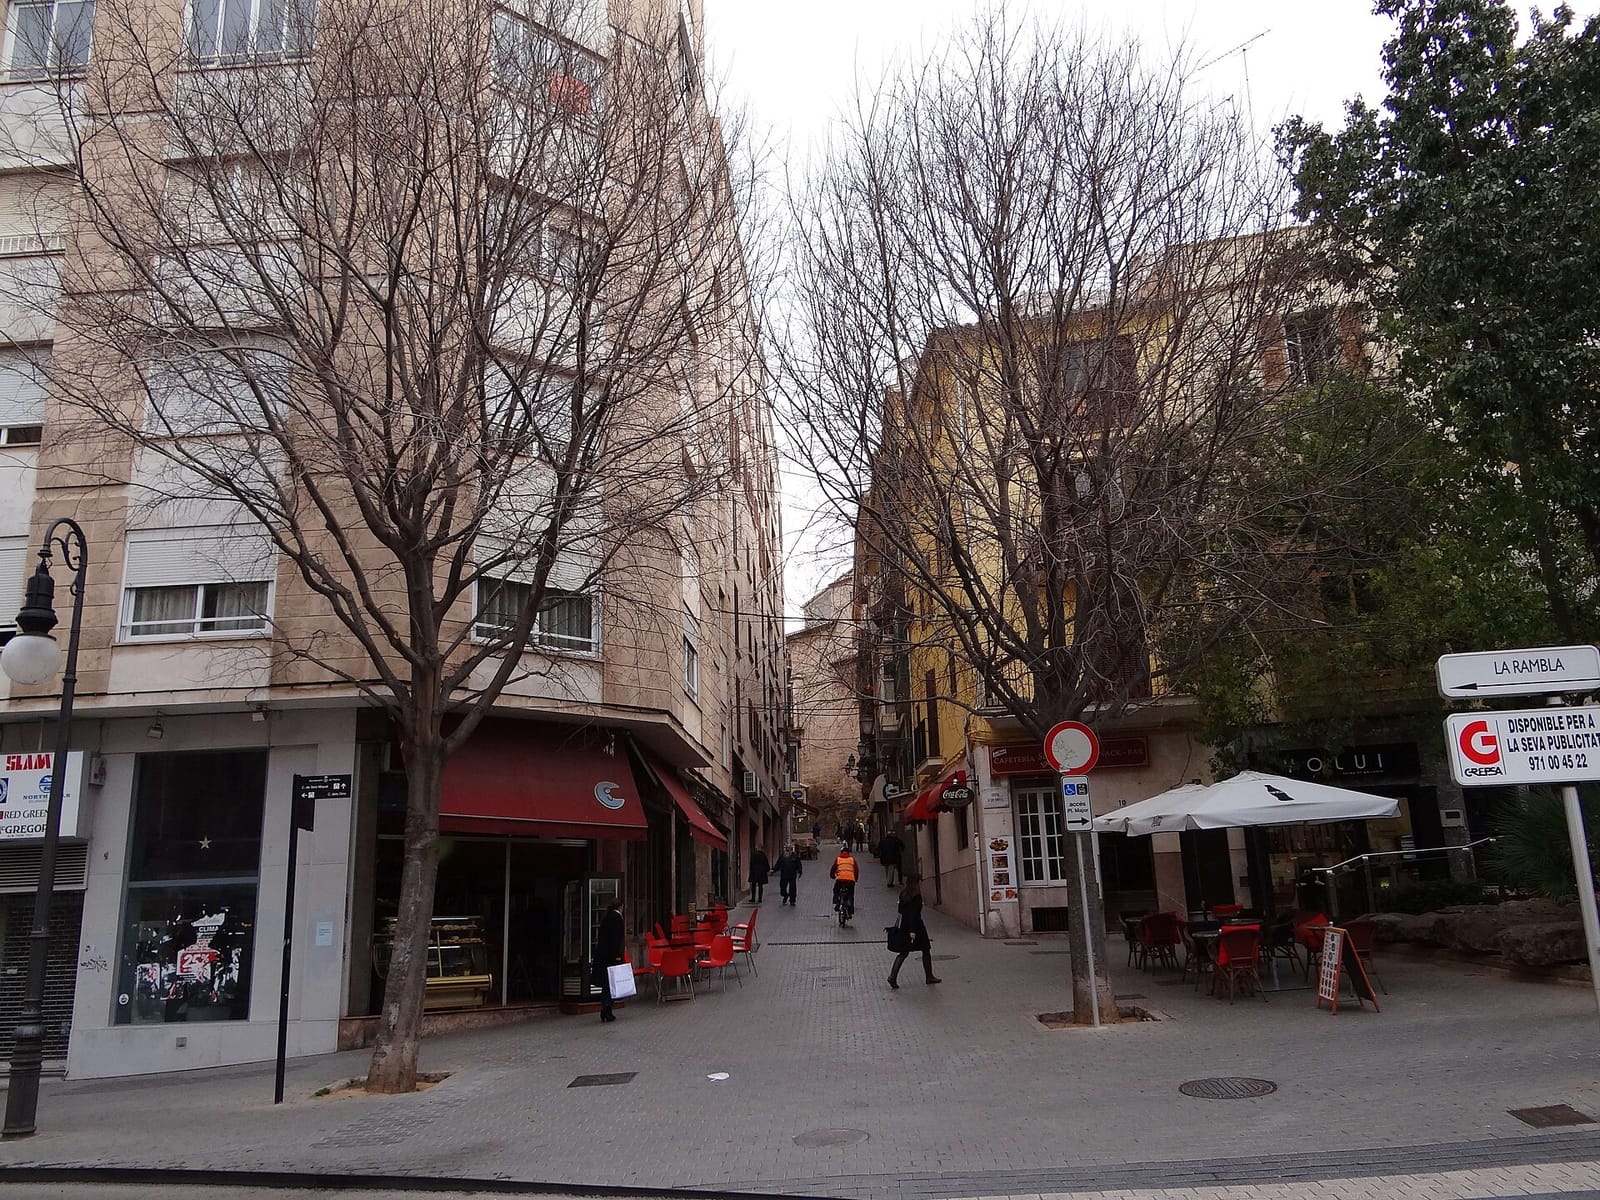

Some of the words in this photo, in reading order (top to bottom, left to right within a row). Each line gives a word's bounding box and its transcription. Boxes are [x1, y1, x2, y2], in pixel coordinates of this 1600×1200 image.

[1494, 661, 1510, 675] LA
[1512, 658, 1565, 674] RAMBLA
[1508, 715, 1565, 733] DISPONIBLE
[1567, 714, 1586, 730] PER
[1588, 714, 1595, 729] A
[1507, 739, 1520, 753] LA
[1521, 737, 1546, 752] SEVA
[6, 754, 51, 770] SLAM
[1529, 756, 1545, 771] 971
[1548, 755, 1560, 770] 00
[1562, 754, 1573, 769] 45
[1575, 753, 1588, 768] 22
[4, 811, 21, 819] RED
